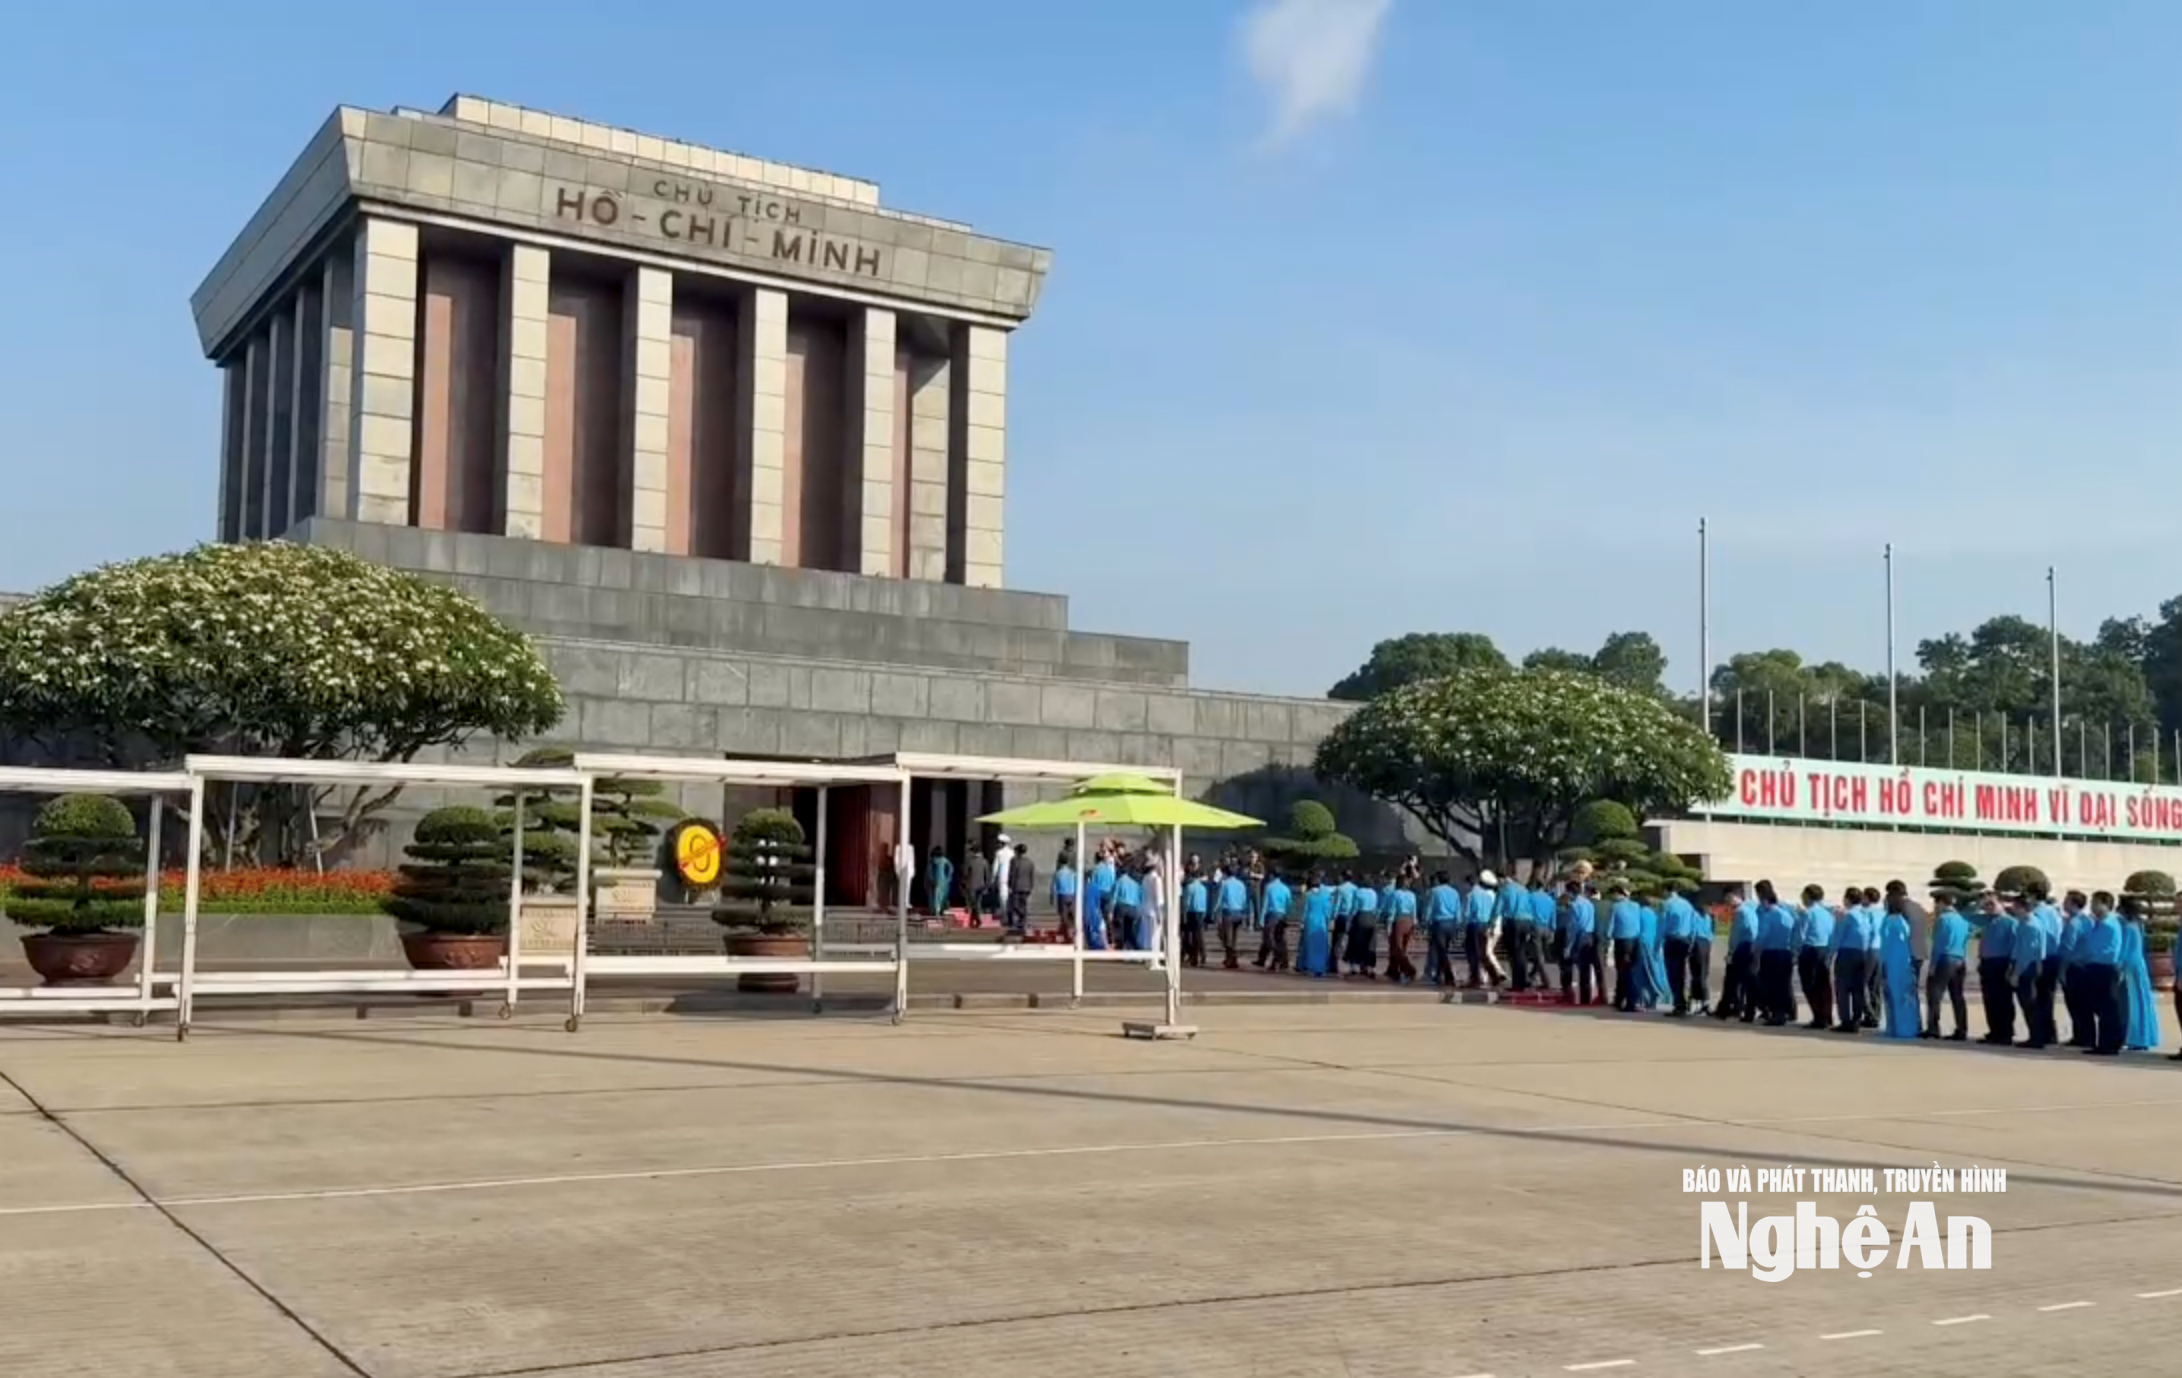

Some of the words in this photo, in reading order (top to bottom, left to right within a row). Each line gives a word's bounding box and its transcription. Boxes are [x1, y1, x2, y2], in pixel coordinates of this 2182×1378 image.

[1740, 760, 1796, 807] CHỦ
[1808, 773, 1867, 817] TỊCH
[1879, 767, 1911, 814] HỒ
[1923, 775, 1964, 819] CHÍ
[1976, 784, 2038, 823] MINH
